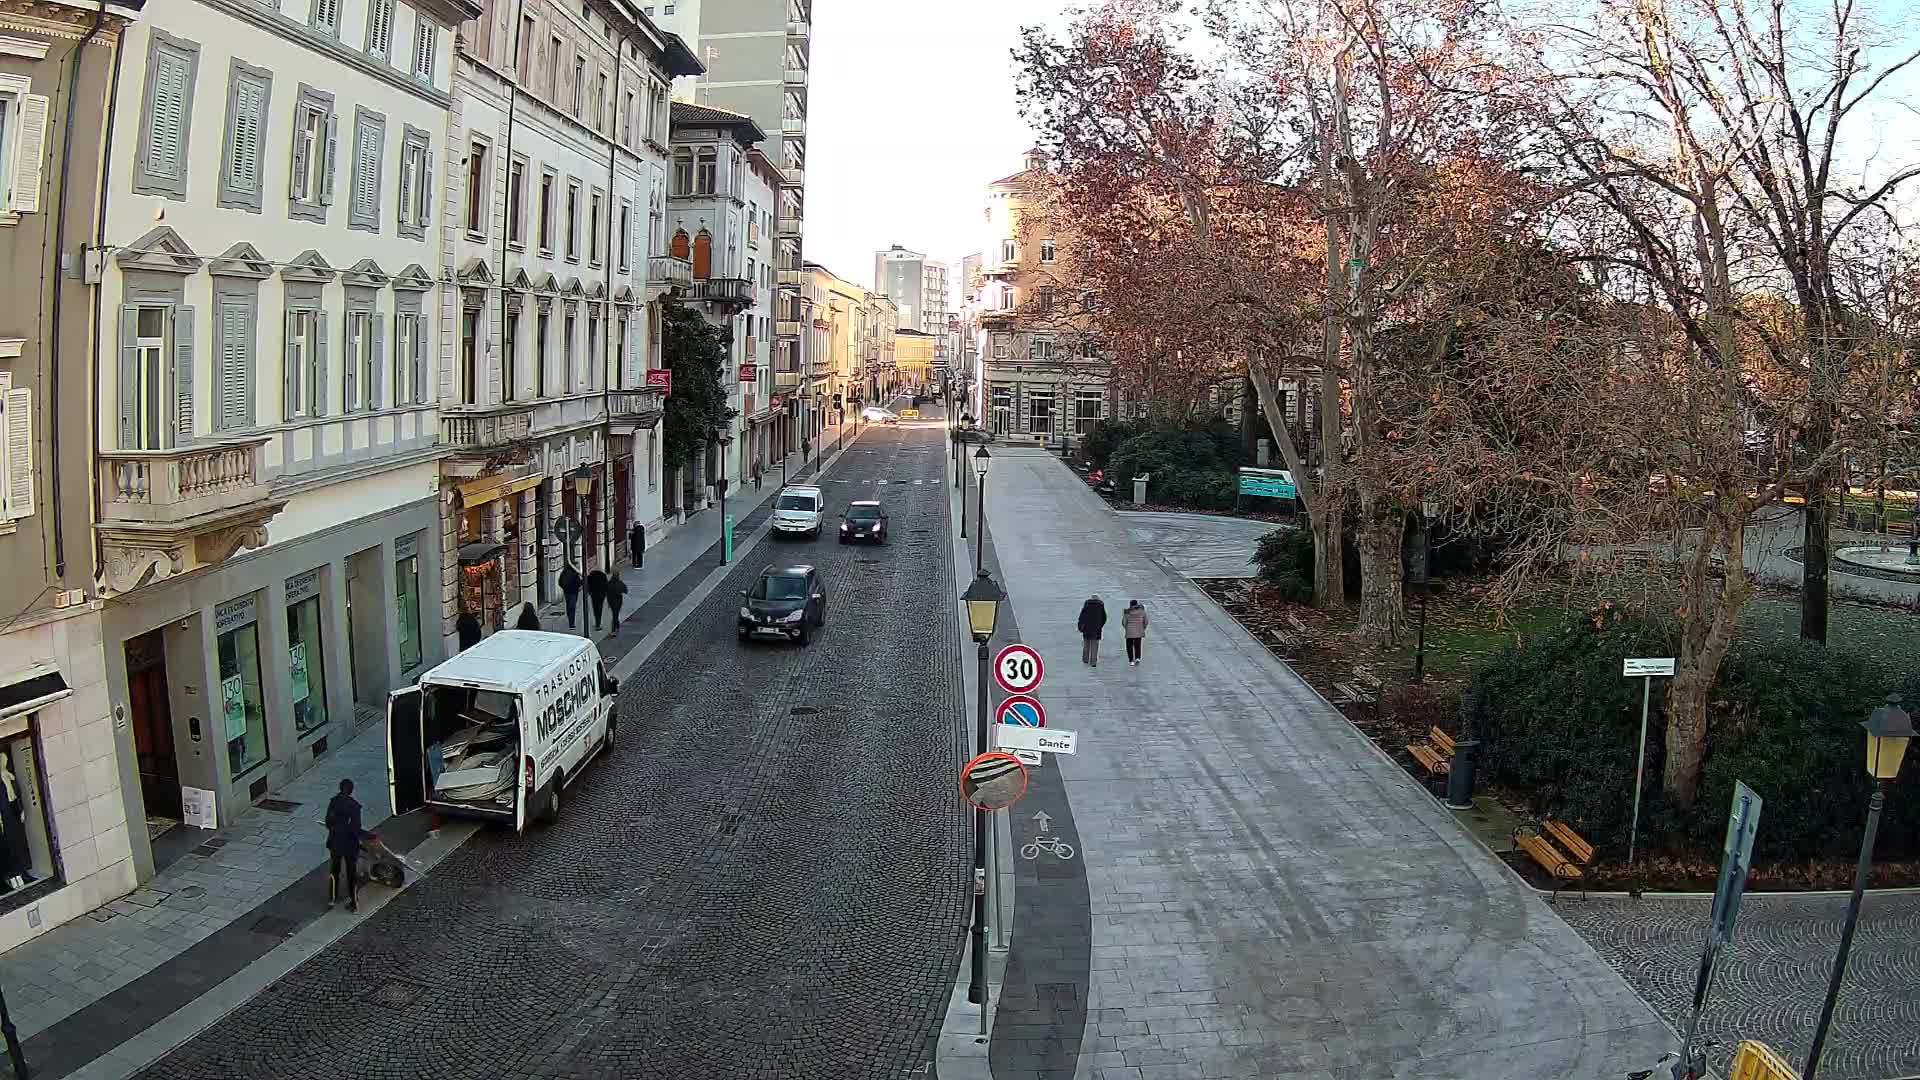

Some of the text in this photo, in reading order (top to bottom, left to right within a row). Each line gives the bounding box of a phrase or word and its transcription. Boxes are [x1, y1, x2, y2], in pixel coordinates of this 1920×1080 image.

[535, 651, 592, 704] TRASLOCHI
[1006, 658, 1033, 680] 30
[536, 669, 596, 745] MOSCHION
[1038, 738, 1071, 749] Dante
